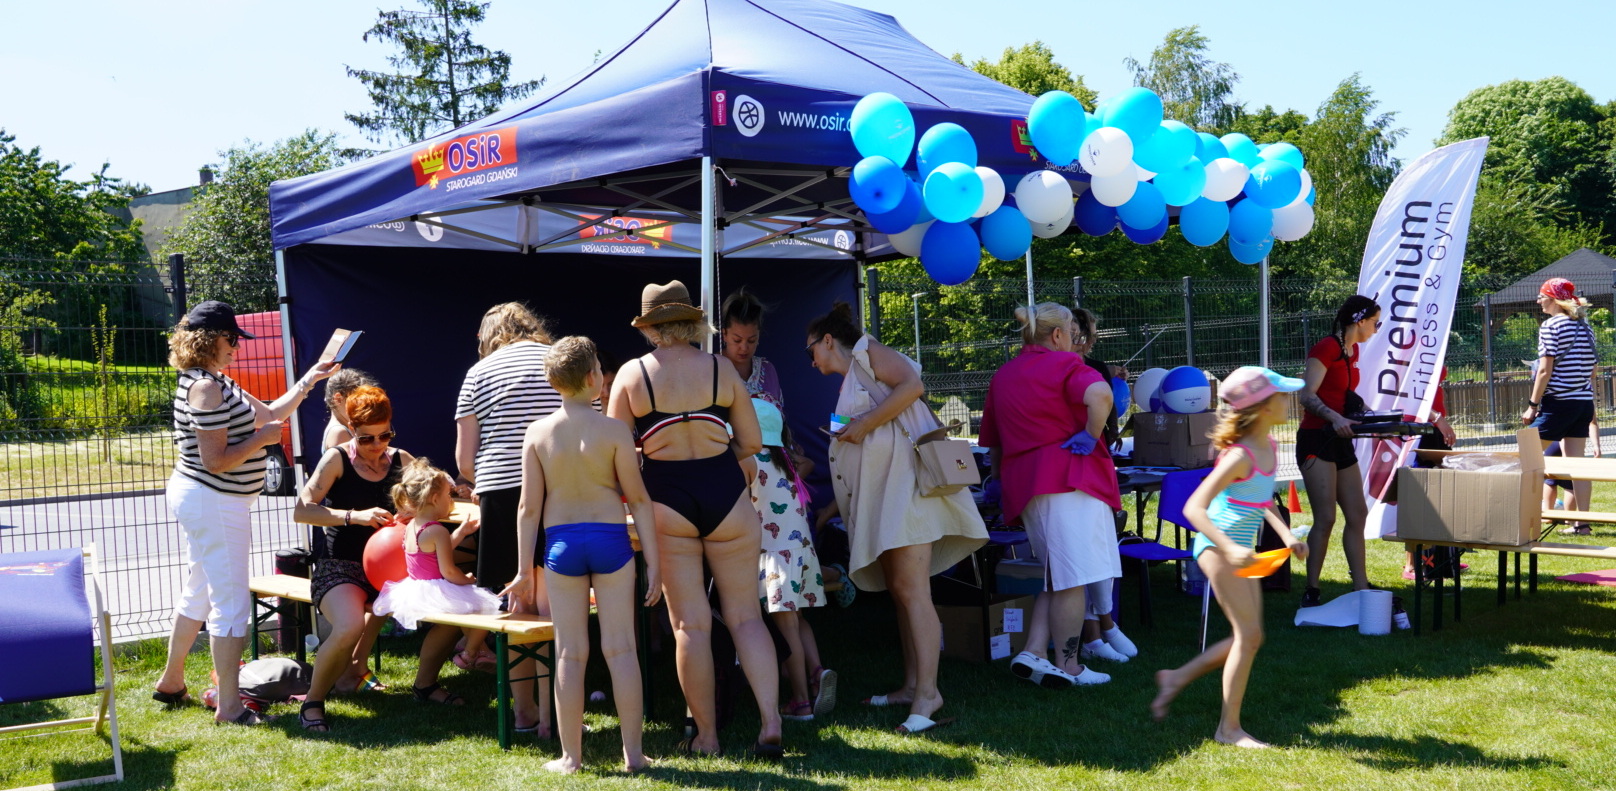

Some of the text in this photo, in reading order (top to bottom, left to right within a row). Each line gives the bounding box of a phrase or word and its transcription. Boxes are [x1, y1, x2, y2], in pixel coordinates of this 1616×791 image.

[446, 166, 518, 192] STAROGARD GDAŃSKI
[1377, 200, 1432, 399] Premium
[1413, 201, 1454, 402] Fitness & Gym
